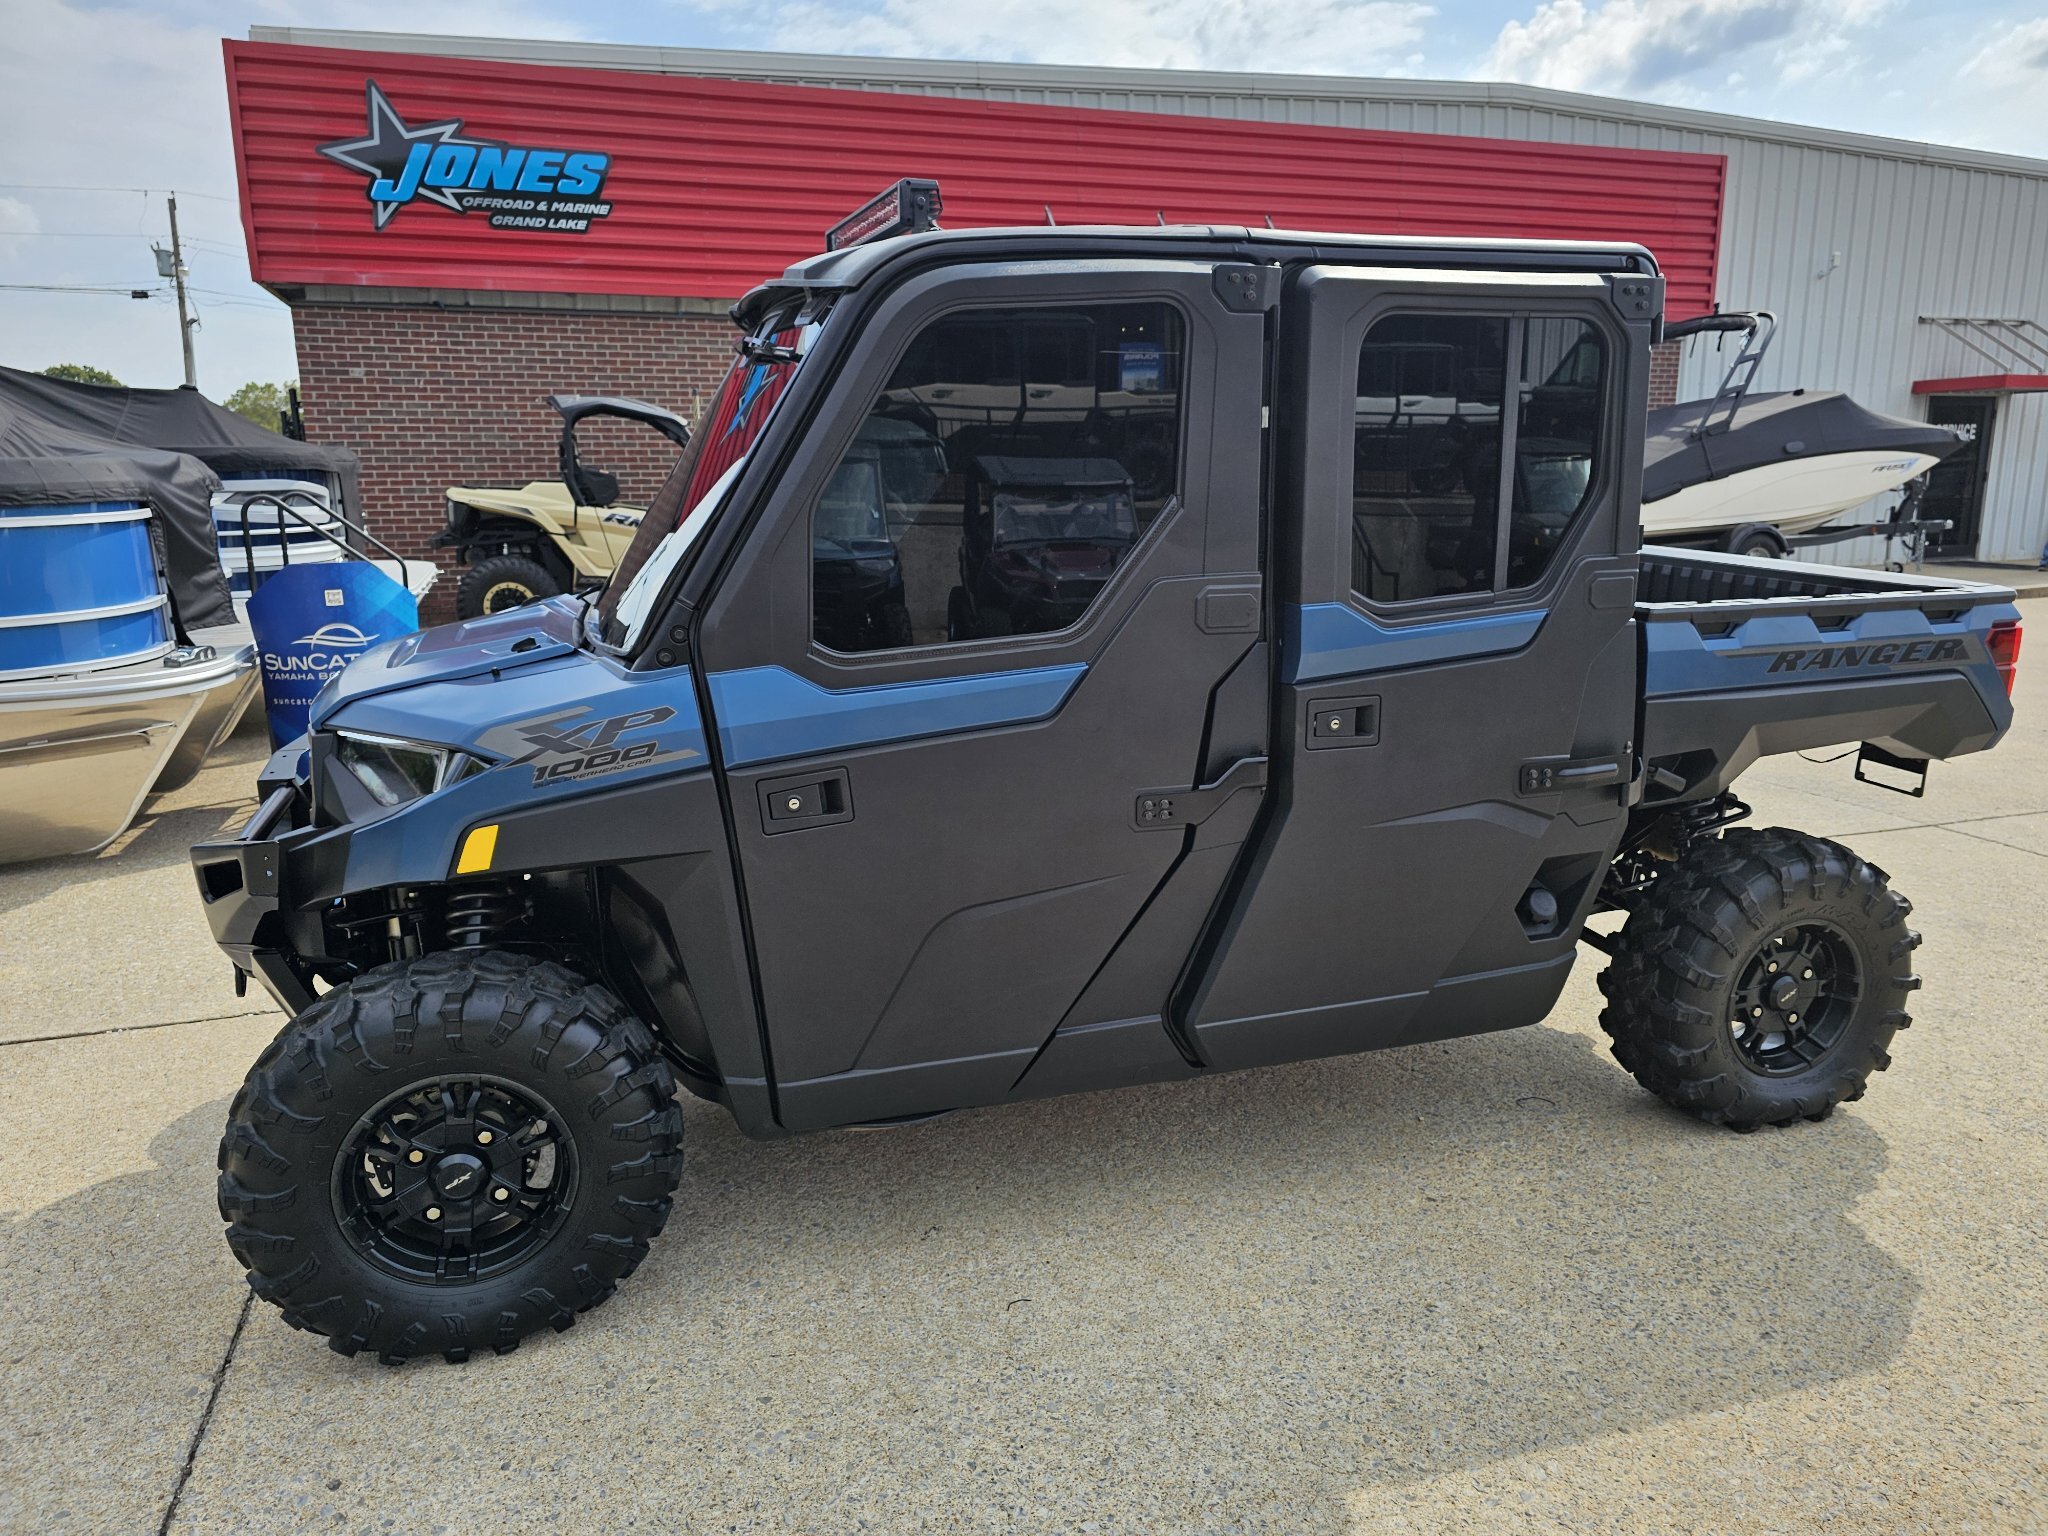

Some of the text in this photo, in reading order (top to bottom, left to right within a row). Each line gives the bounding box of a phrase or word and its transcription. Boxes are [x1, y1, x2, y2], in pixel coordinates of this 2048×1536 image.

[370, 143, 608, 202] JONES
[462, 196, 611, 215] OFFROAD & MARINE
[491, 215, 588, 231] GRAND LAKE
[1767, 638, 1970, 673] RANGER
[268, 672, 315, 680] YAMAHA
[502, 706, 678, 768] XP
[533, 742, 658, 782] 1000
